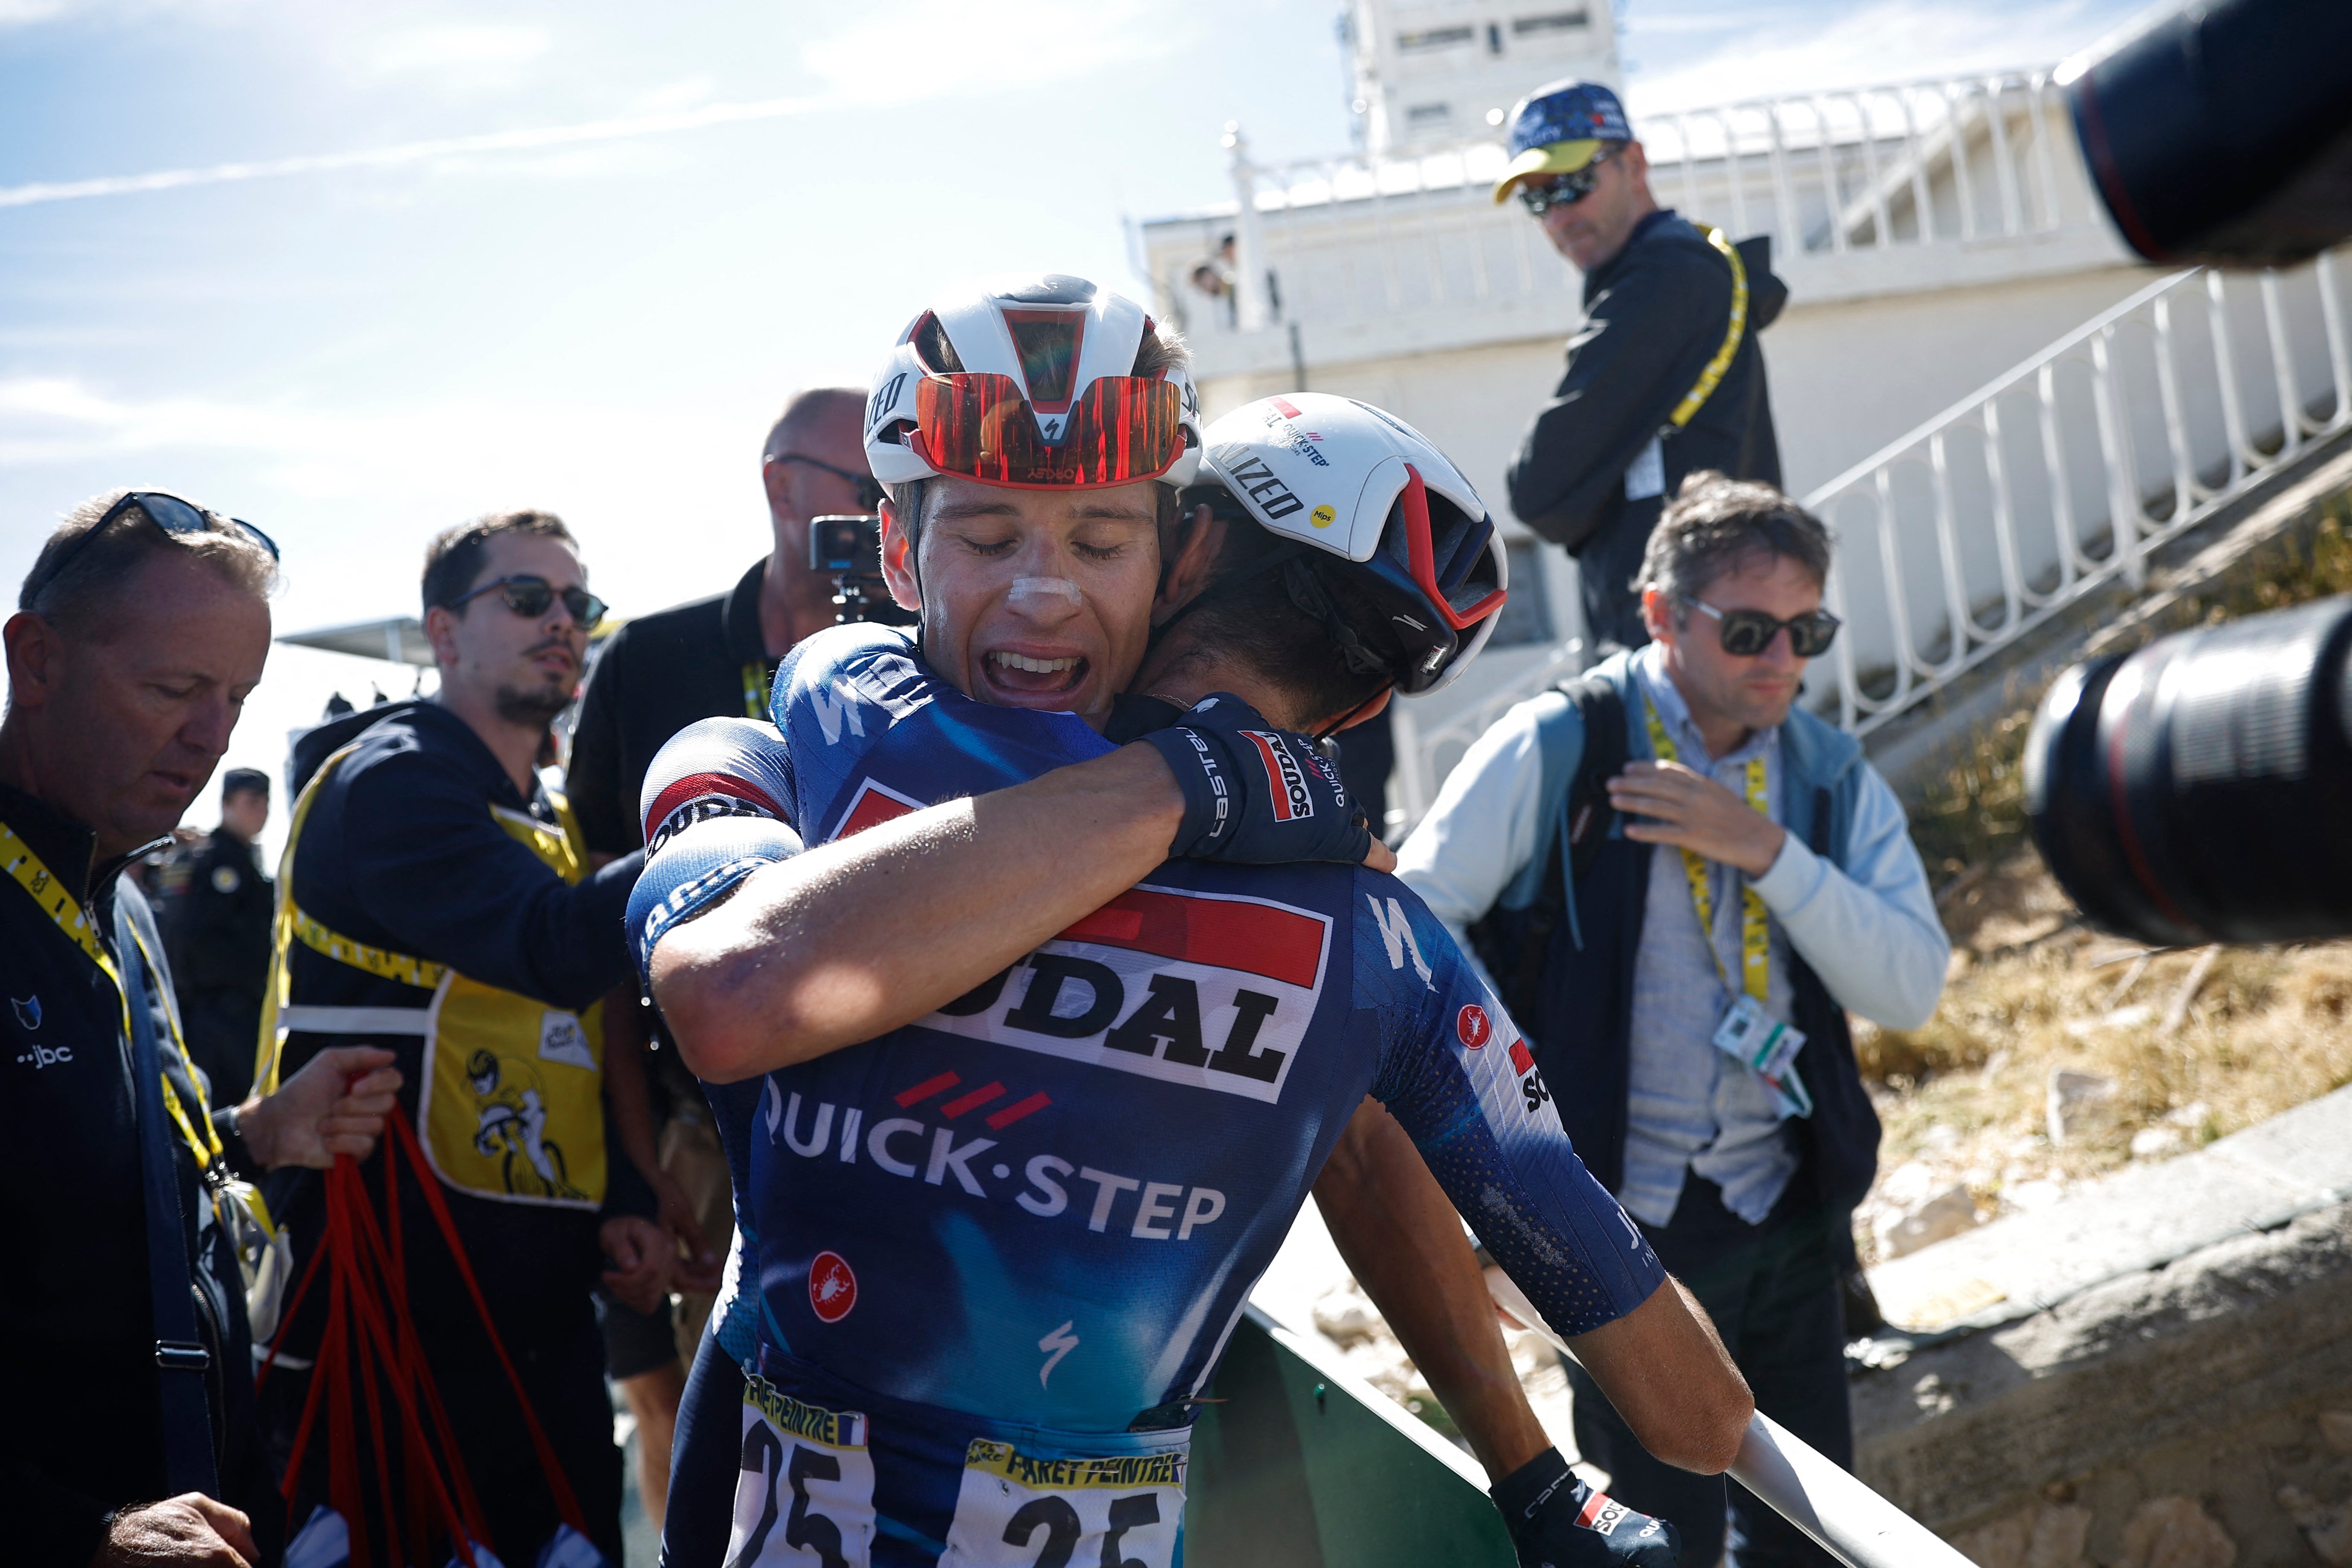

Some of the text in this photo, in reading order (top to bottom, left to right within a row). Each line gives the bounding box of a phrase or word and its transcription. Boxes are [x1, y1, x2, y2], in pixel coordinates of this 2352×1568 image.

[1027, 468, 1075, 480] OAKLEY
[1314, 510, 1332, 522] Mips
[32, 1045, 73, 1070] jbc
[1006, 1449, 1172, 1485] PARET PEINTRE
[726, 1419, 849, 1568] 25
